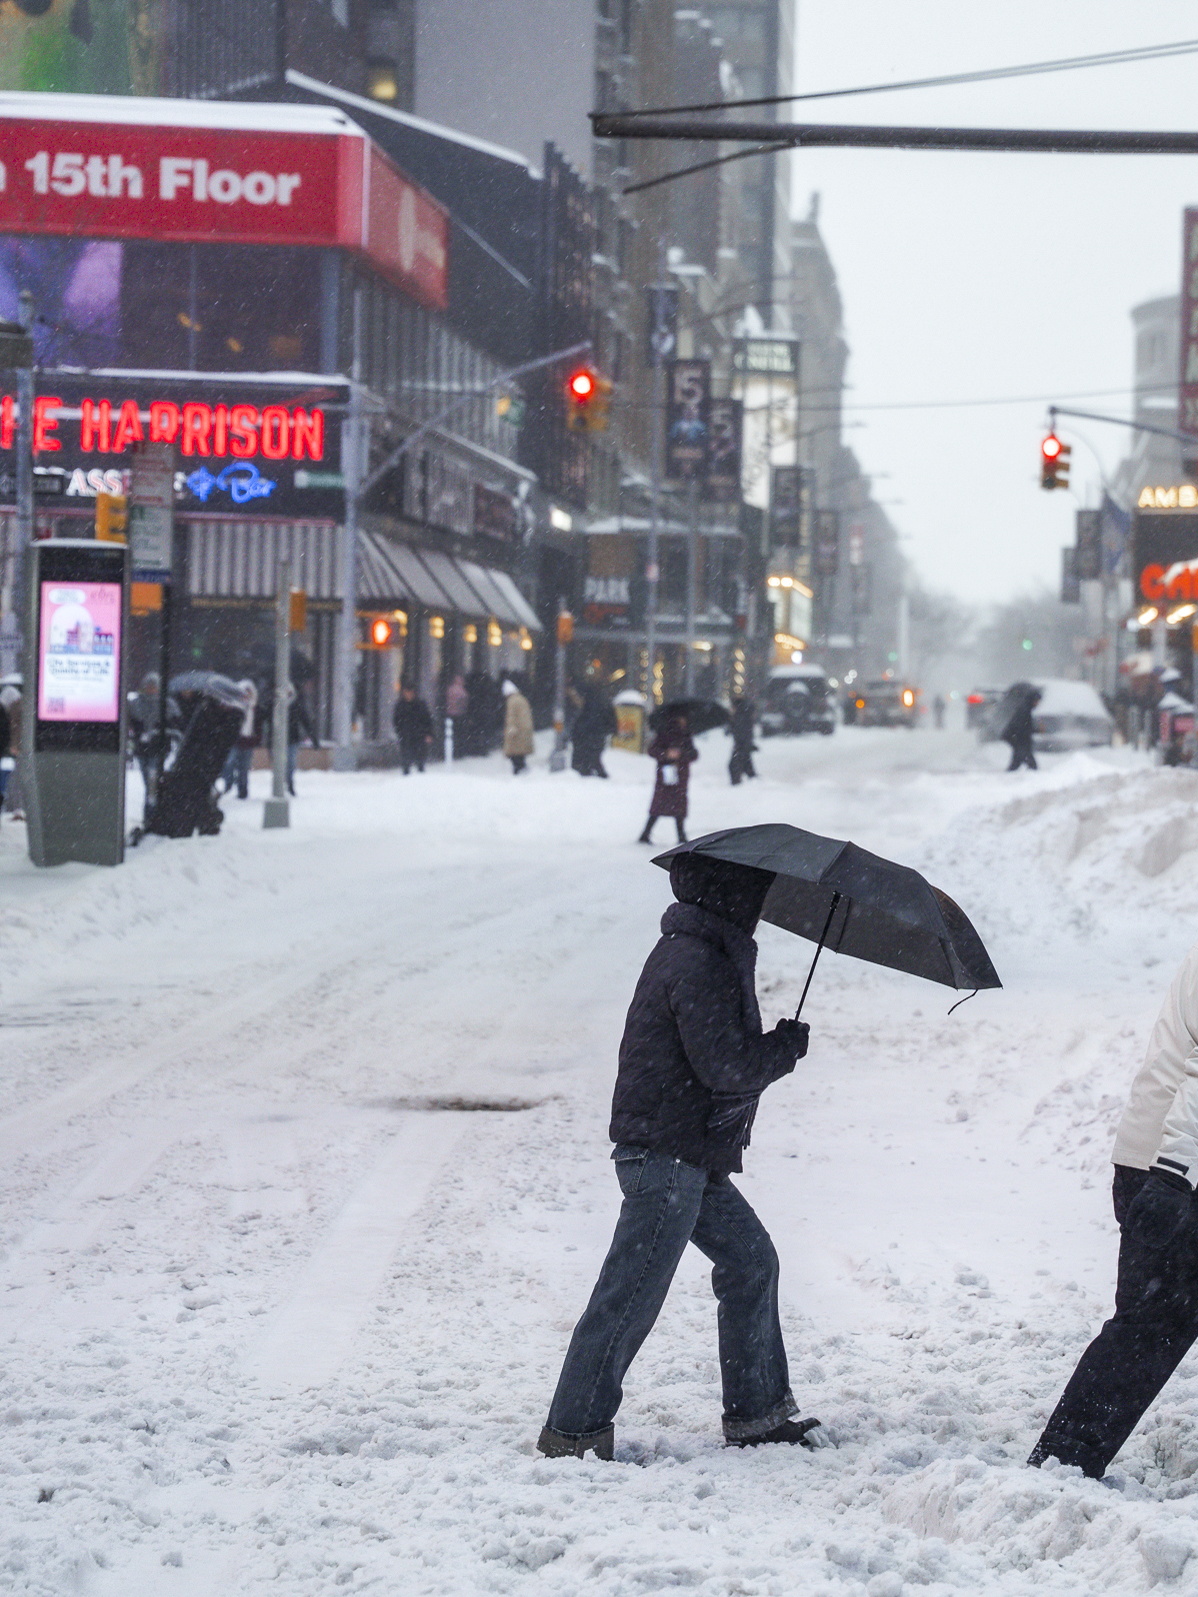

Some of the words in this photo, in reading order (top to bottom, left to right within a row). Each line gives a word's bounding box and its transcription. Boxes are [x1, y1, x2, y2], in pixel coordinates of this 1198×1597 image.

[24, 150, 143, 199] 15th
[159, 157, 299, 205] Floor
[80, 398, 324, 460] HARRISON
[582, 577, 630, 603] PARK
